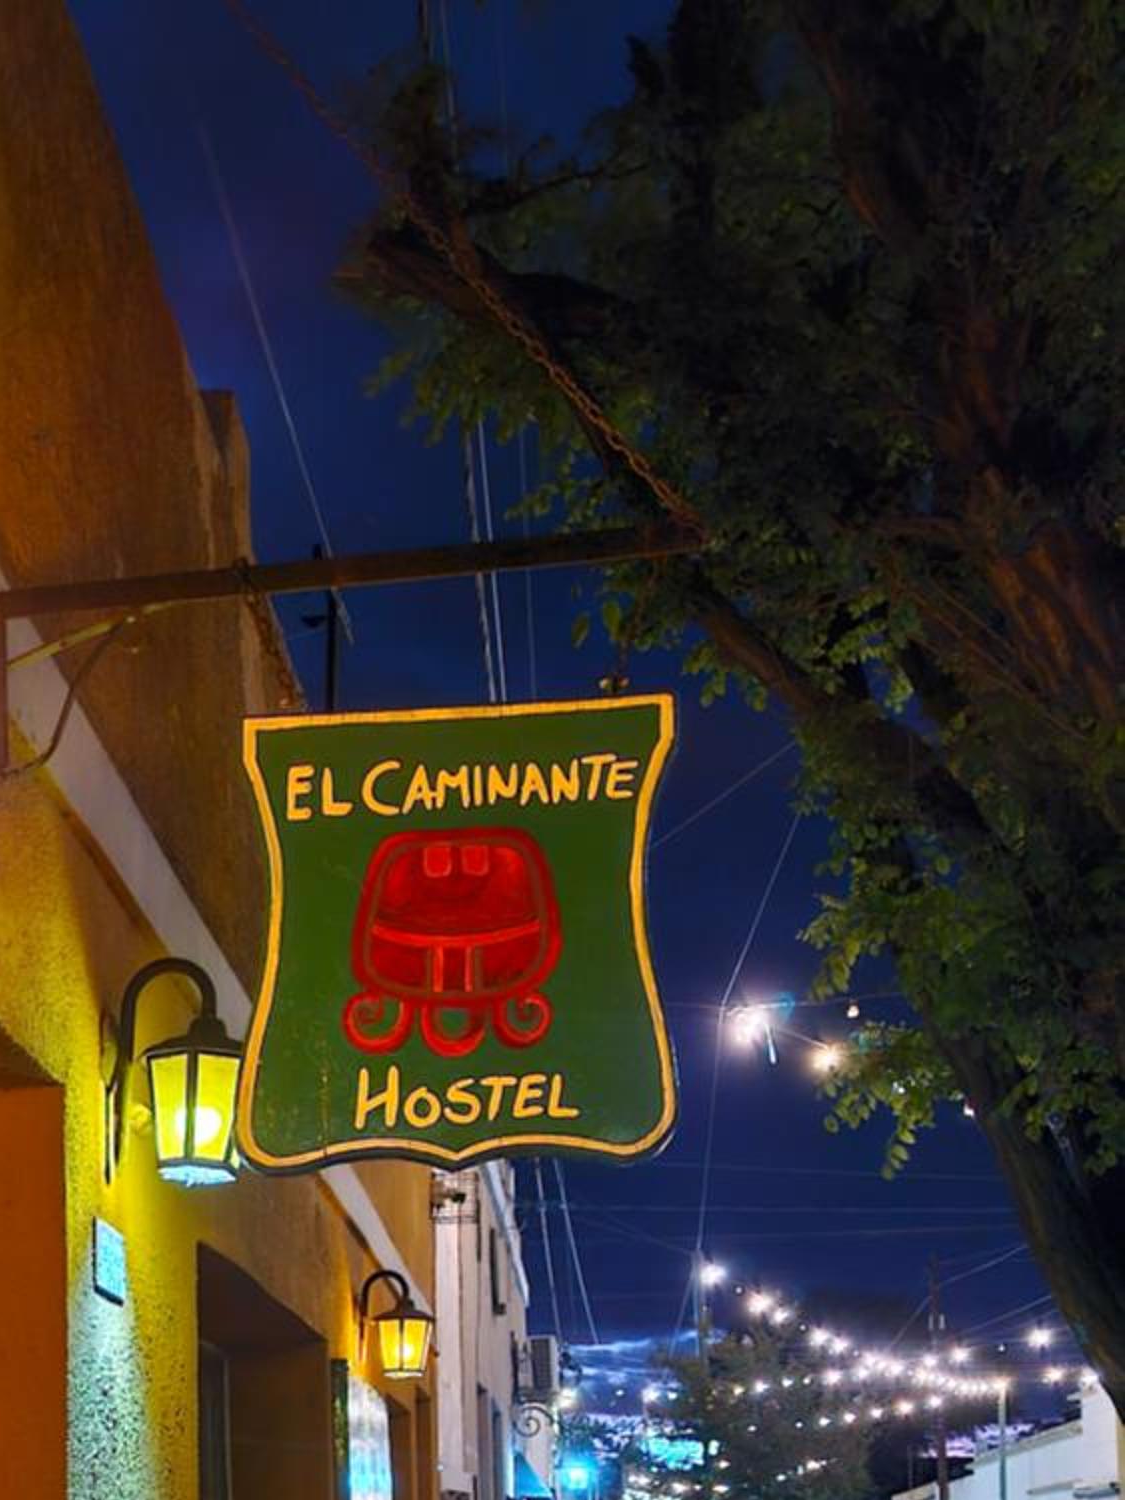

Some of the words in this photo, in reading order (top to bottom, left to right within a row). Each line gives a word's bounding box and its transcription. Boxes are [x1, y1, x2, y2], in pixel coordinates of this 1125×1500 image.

[285, 764, 354, 822] EL
[361, 753, 640, 817] CAMINANTE
[354, 1065, 580, 1131] HOSTEL
